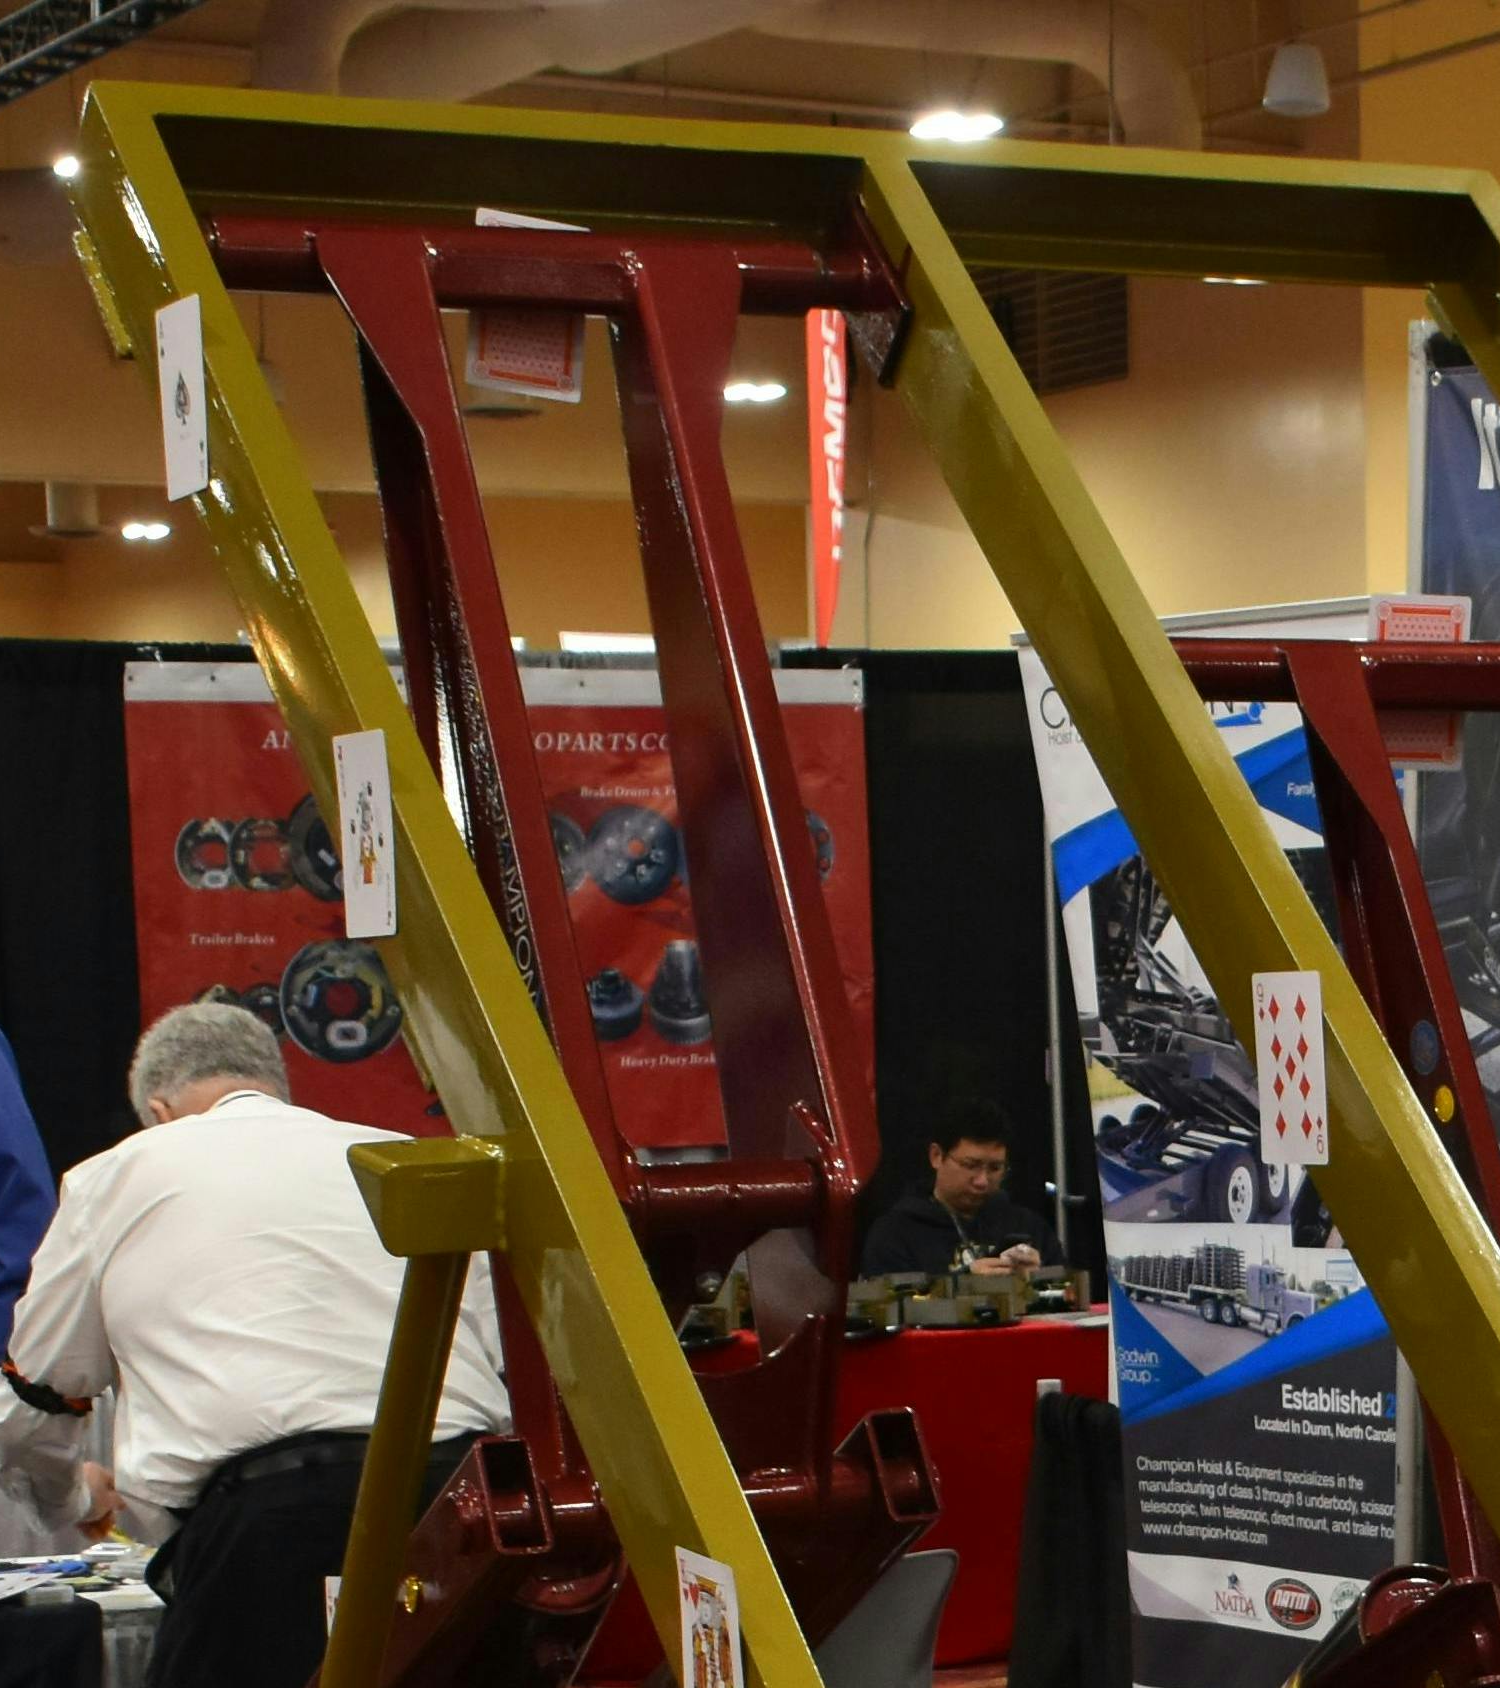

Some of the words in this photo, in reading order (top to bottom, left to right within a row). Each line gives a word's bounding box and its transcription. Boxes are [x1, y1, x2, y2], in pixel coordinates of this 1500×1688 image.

[1281, 1384, 1382, 1416] Established
[1254, 1415, 1290, 1432] Located
[1302, 1422, 1334, 1440] Dunn,
[1335, 1423, 1363, 1439] North
[1136, 1455, 1195, 1474] Champion
[1197, 1459, 1223, 1474] Hoist
[1224, 1462, 1233, 1476] &
[1235, 1462, 1282, 1482] Equipment
[1283, 1468, 1335, 1488] specializes
[1336, 1472, 1347, 1488] in
[1348, 1474, 1363, 1490] the
[1138, 1480, 1215, 1498] manufacturing
[1216, 1481, 1228, 1496] of
[1229, 1485, 1253, 1500] class
[1254, 1487, 1261, 1500] 3
[1262, 1487, 1295, 1506] through
[1304, 1493, 1358, 1515] underbody,
[1140, 1499, 1198, 1517] telescopic,
[1200, 1501, 1221, 1517] twin
[1222, 1505, 1270, 1524] telescopic,
[1271, 1510, 1295, 1526] direct
[1296, 1514, 1329, 1531] mount,
[1331, 1516, 1350, 1533] and
[1352, 1519, 1379, 1536] trailer
[1214, 1590, 1257, 1618] NATDA
